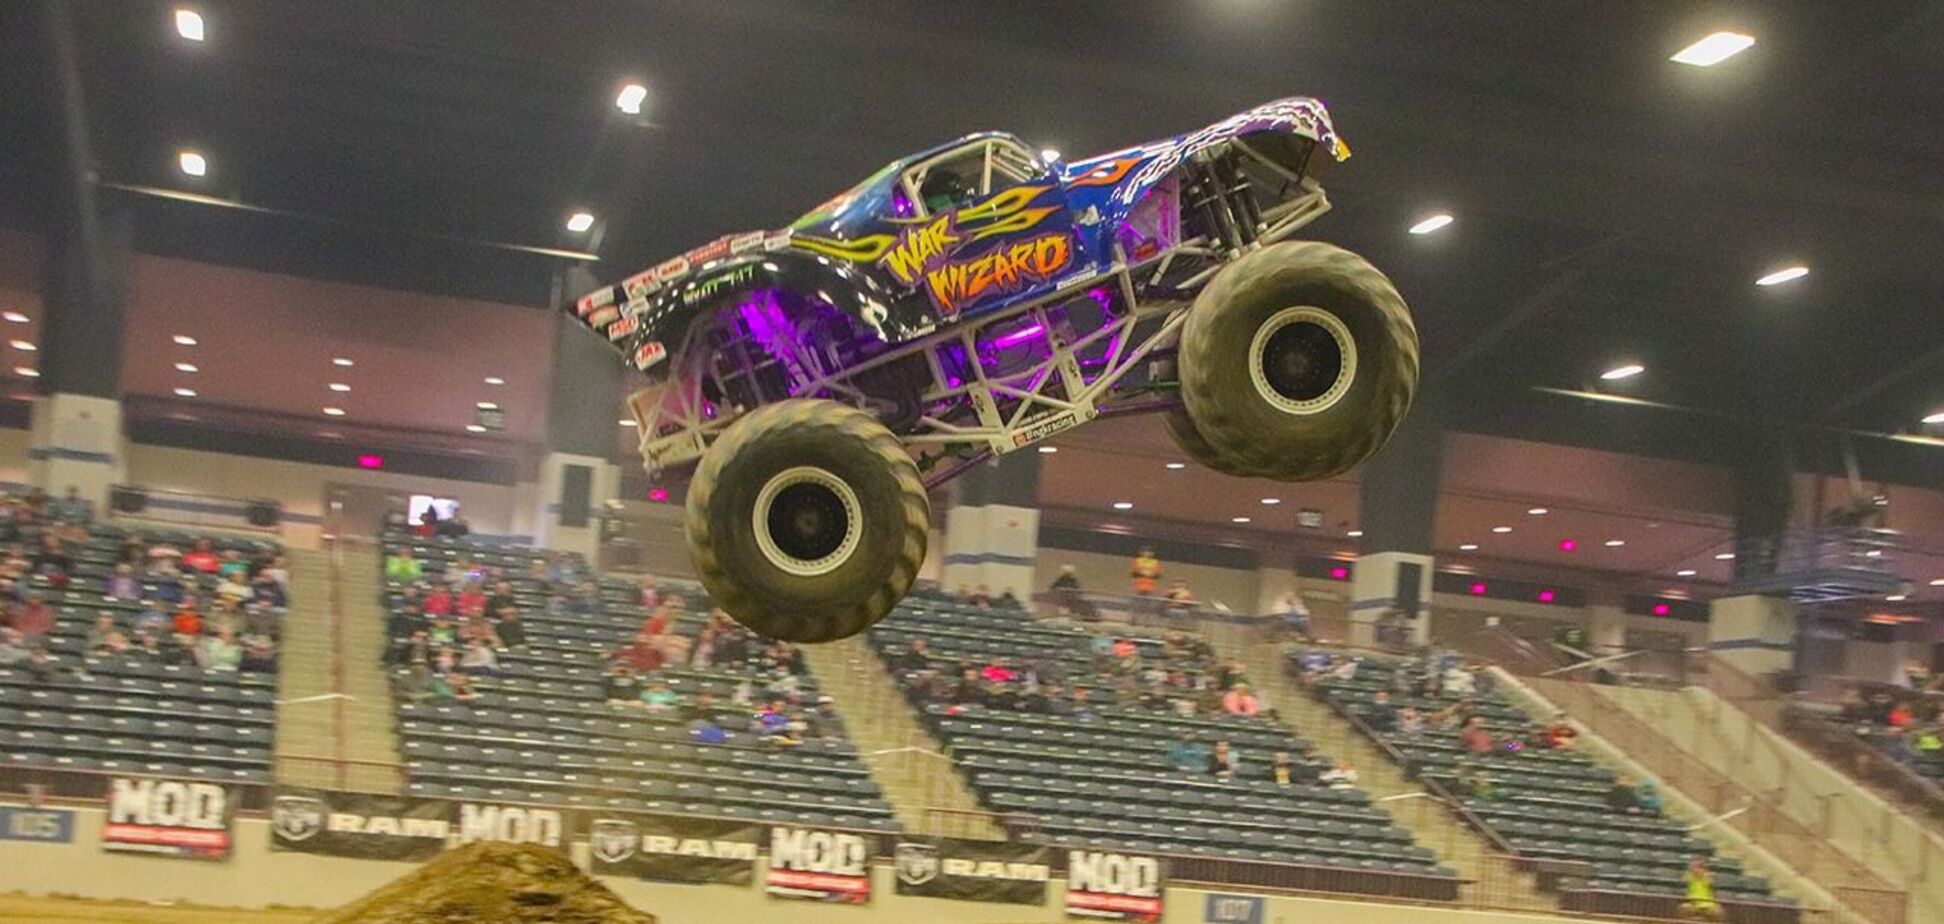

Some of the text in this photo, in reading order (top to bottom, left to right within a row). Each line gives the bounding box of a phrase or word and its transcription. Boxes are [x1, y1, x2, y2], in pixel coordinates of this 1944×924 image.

[879, 215, 960, 283] WAR
[927, 236, 1069, 310] WIZARD
[111, 778, 226, 829] MOD
[328, 812, 449, 838] RAM
[642, 835, 757, 861] RAM
[771, 827, 867, 876] MOD
[943, 858, 1050, 881] RAM
[1069, 850, 1160, 897] MOD
